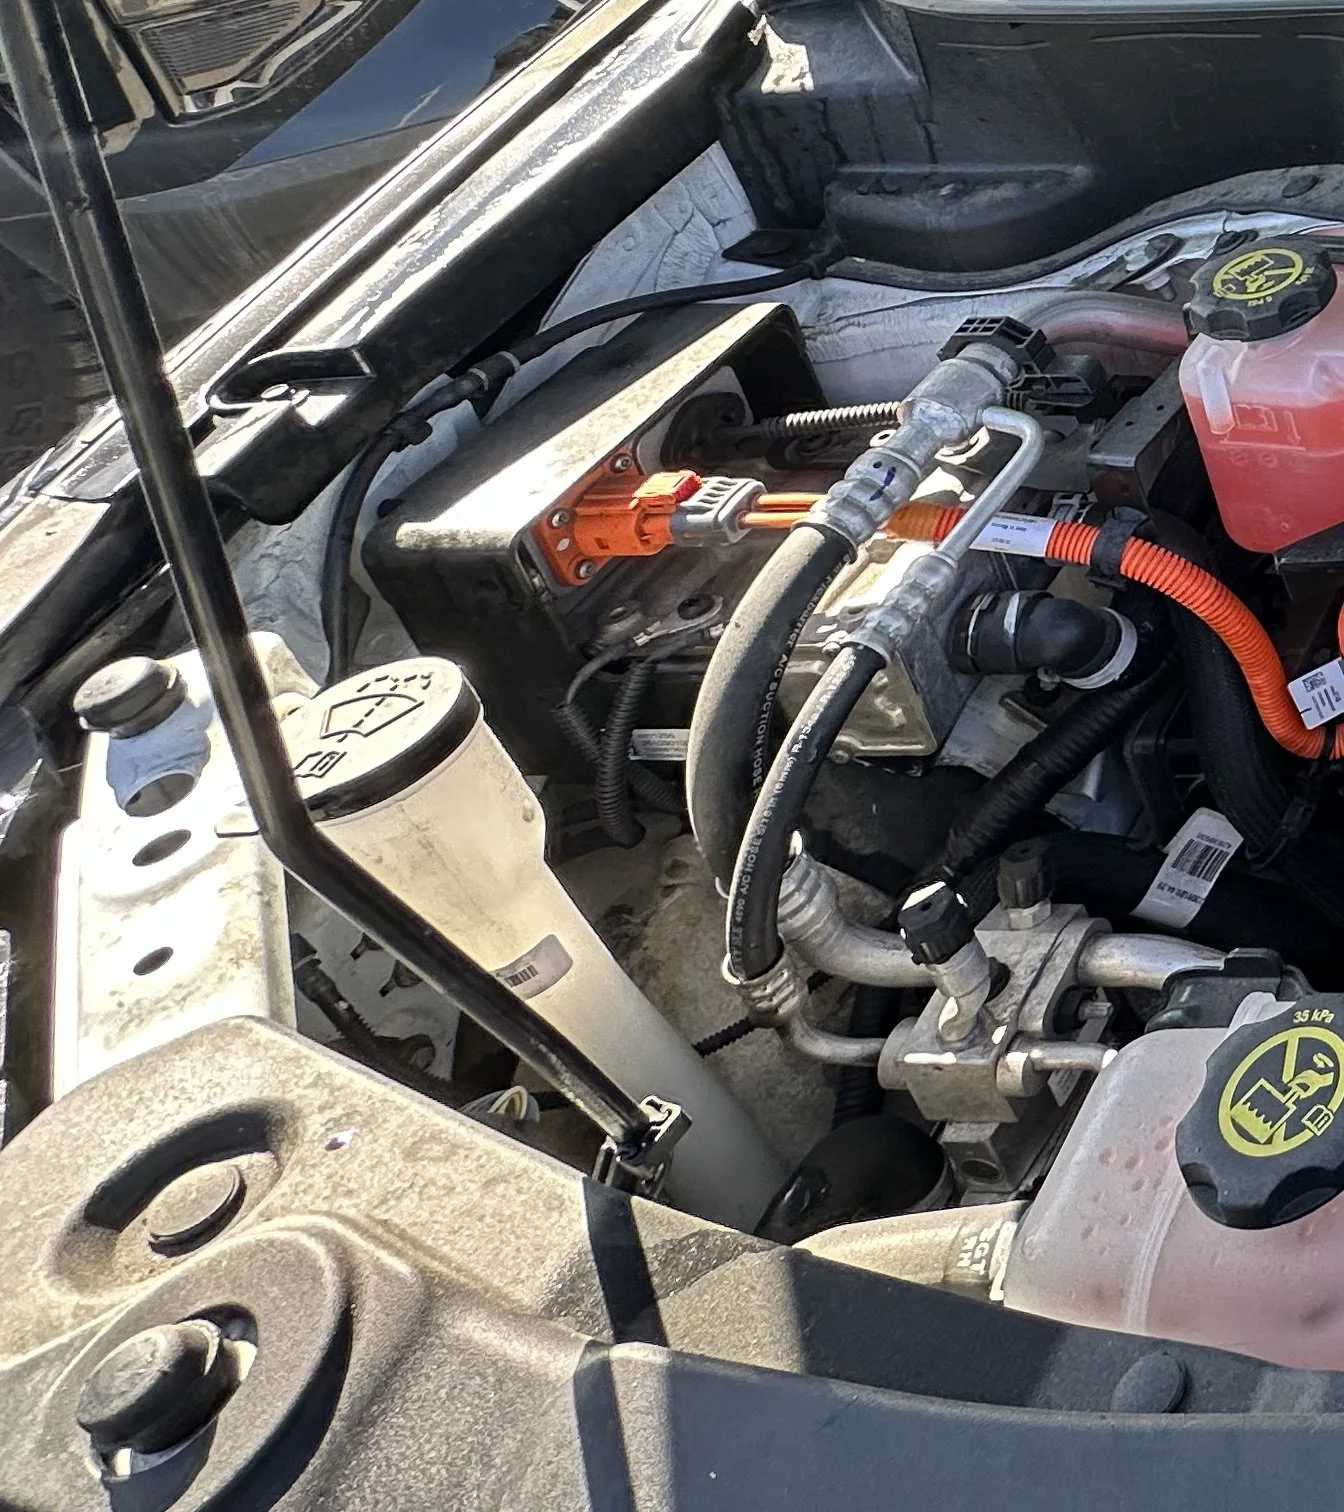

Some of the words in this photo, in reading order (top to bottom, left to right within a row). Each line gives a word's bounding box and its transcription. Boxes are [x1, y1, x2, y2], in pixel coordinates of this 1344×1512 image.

[757, 681, 778, 746] SUCTION
[752, 747, 765, 787] HOSE
[1293, 1010, 1310, 1023] 35
[1310, 1008, 1335, 1023] kPa
